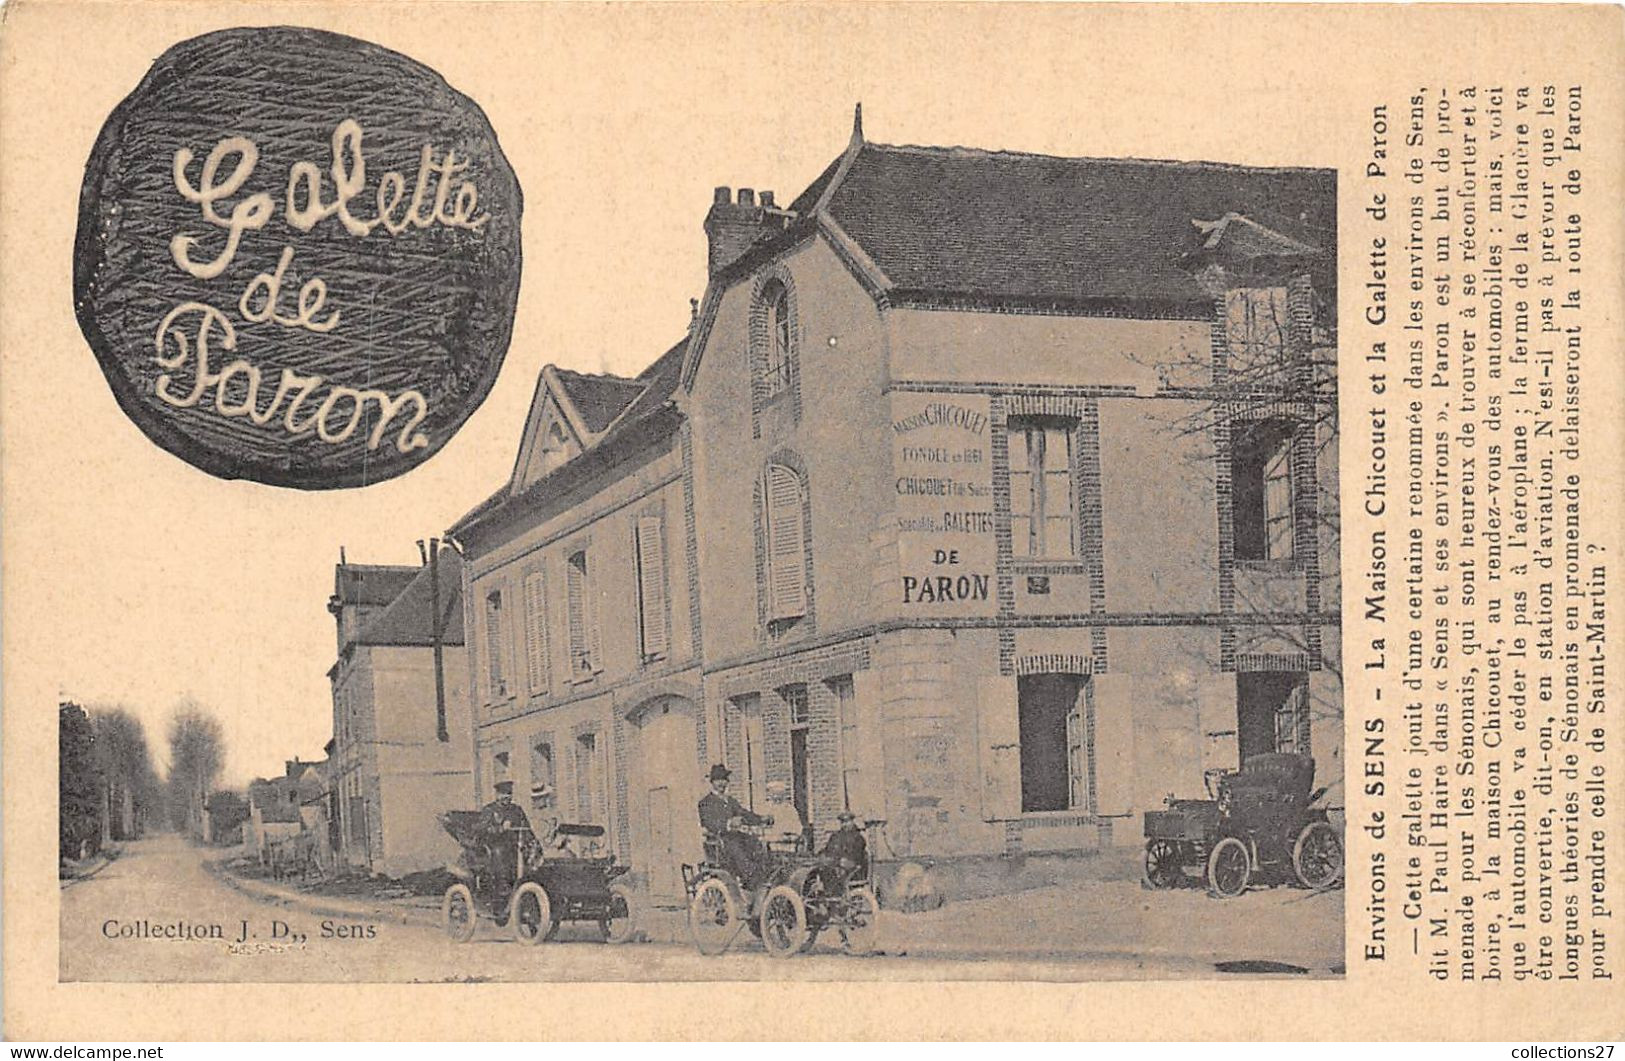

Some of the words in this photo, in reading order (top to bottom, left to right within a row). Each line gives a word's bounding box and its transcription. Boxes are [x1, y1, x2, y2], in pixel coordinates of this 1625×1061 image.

[170, 118, 491, 279] Galette
[239, 246, 340, 332] de
[155, 302, 429, 453] Paron
[924, 403, 988, 435] CHICOUET
[932, 550, 960, 565] DE
[903, 575, 990, 604] PARON
